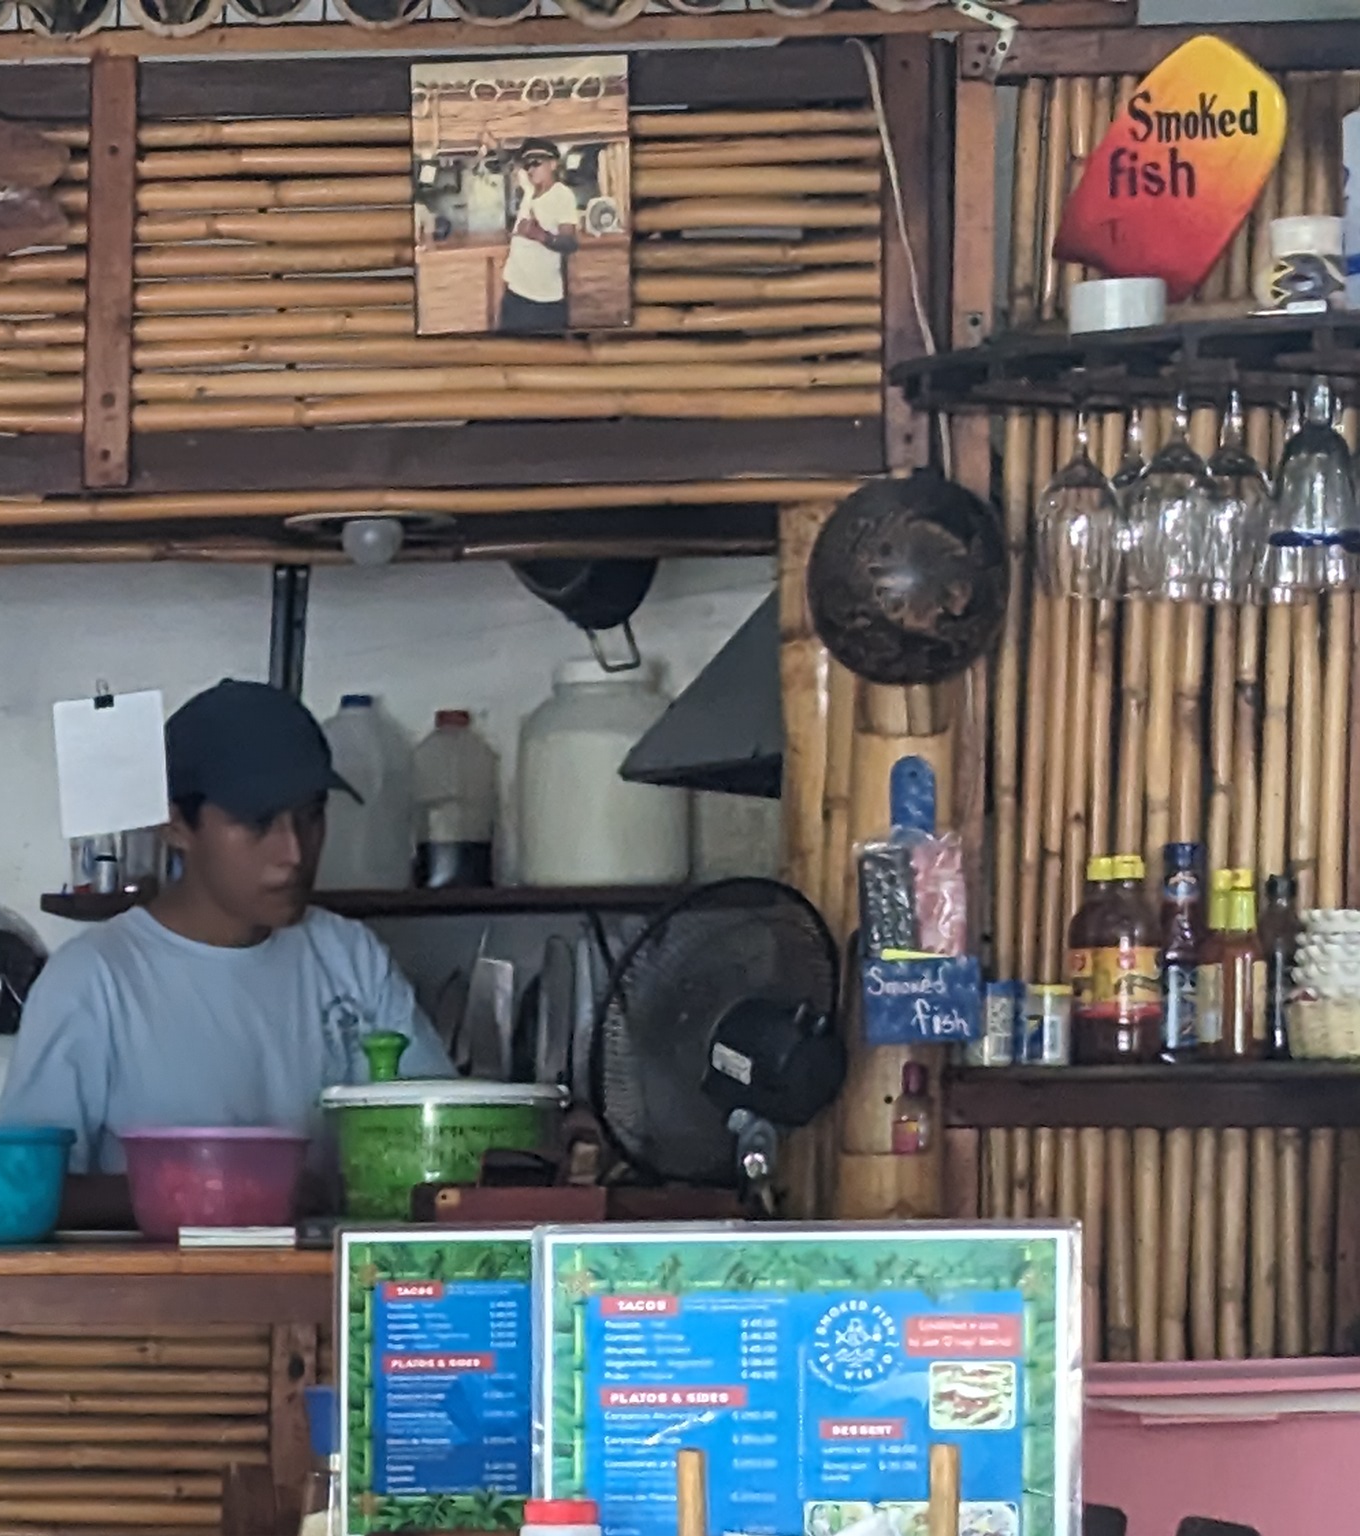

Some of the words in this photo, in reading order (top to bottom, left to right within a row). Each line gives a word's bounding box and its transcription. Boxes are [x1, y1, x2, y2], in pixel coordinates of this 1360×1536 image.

[1108, 147, 1197, 198] fish
[396, 1286, 434, 1296] TACOS
[617, 1300, 667, 1311] TACOS
[815, 1299, 869, 1336] SMOKED
[610, 1392, 668, 1404] PLATOS
[686, 1392, 730, 1403] SIDES
